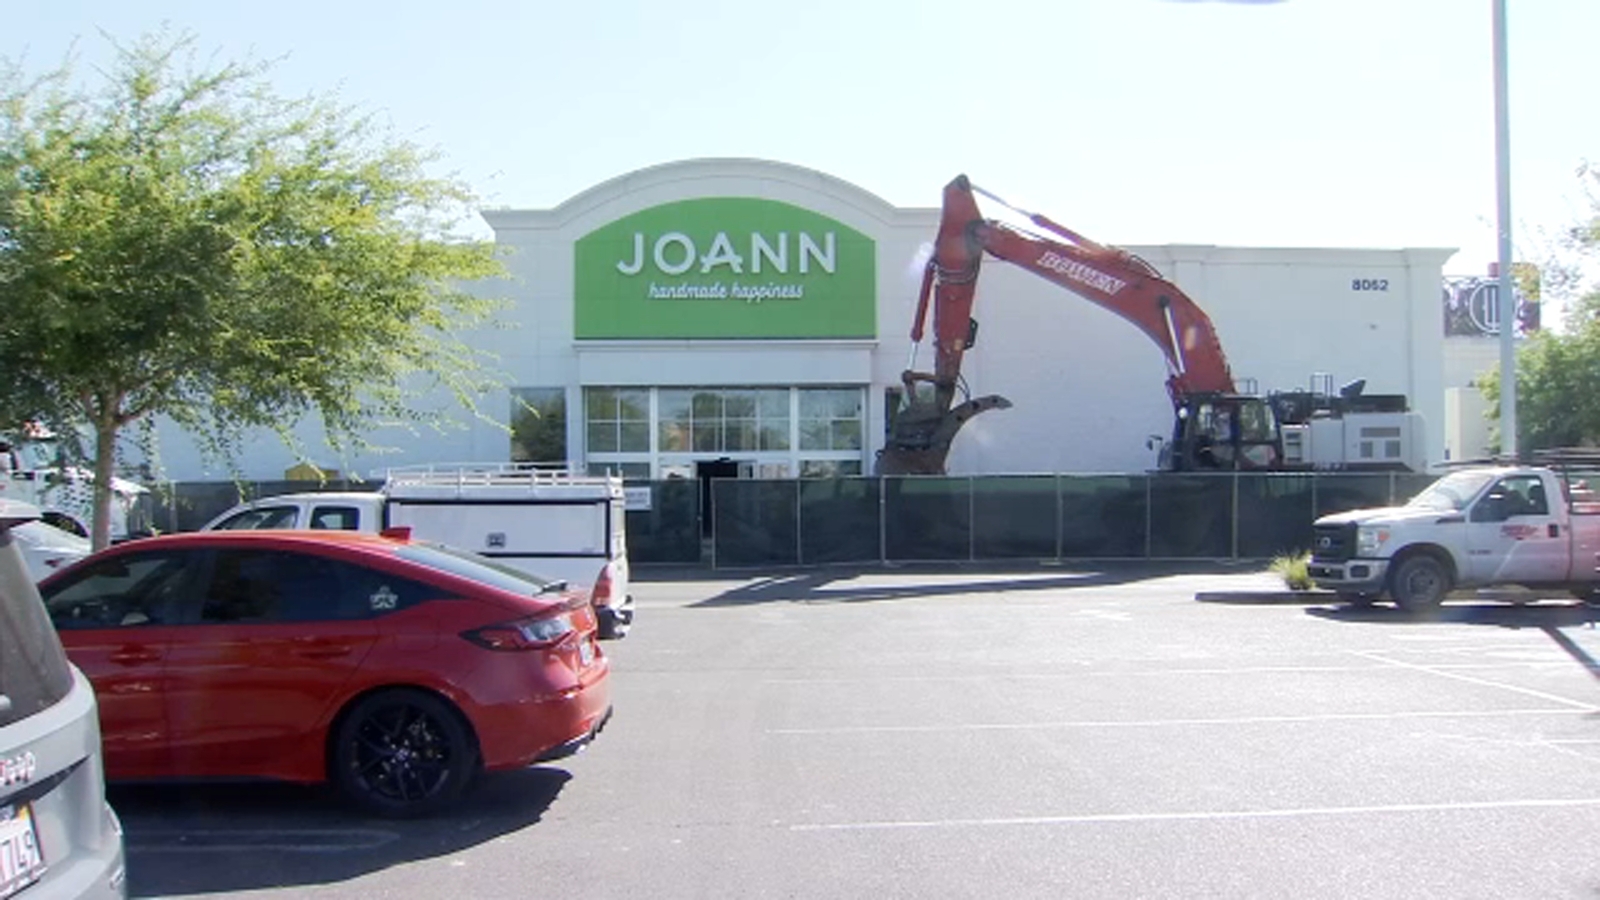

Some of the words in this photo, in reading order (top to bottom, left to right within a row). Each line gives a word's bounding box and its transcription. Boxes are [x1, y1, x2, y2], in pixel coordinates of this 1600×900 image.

[616, 231, 836, 276] JOANN
[649, 281, 727, 299] handmade
[731, 281, 803, 303] happiness
